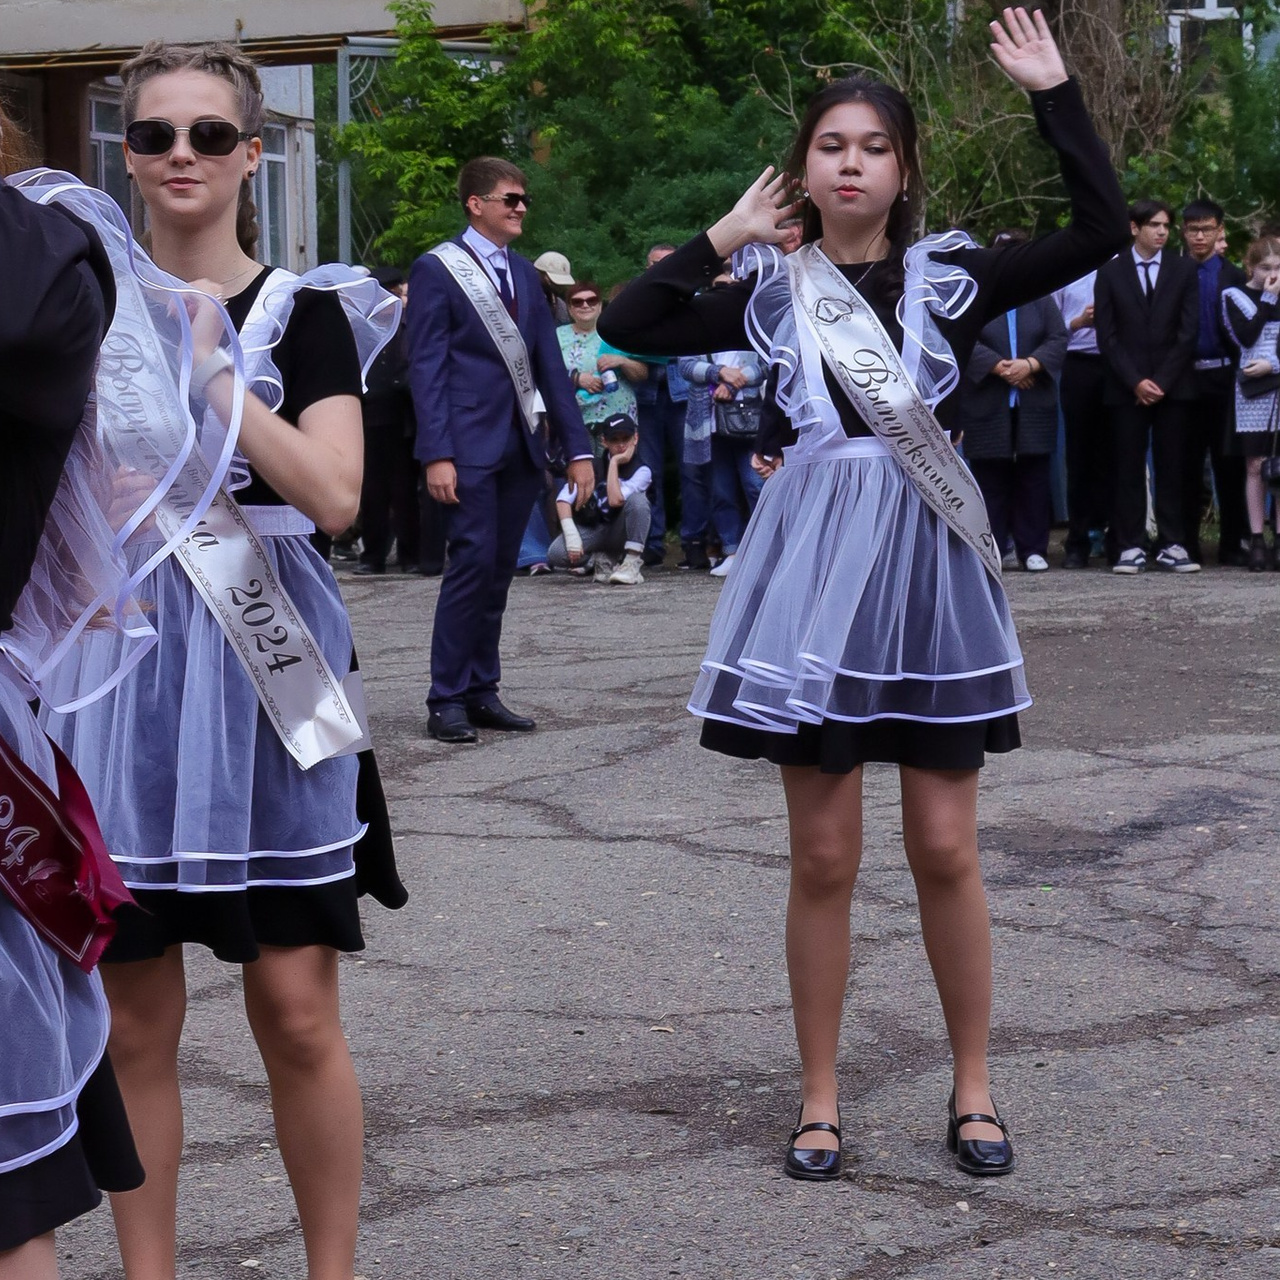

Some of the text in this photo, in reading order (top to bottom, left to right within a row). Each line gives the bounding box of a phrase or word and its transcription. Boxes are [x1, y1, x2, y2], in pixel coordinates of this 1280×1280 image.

[514, 358, 531, 396] 2024
[838, 348, 966, 515] Выпускница
[224, 578, 303, 677] 2024
